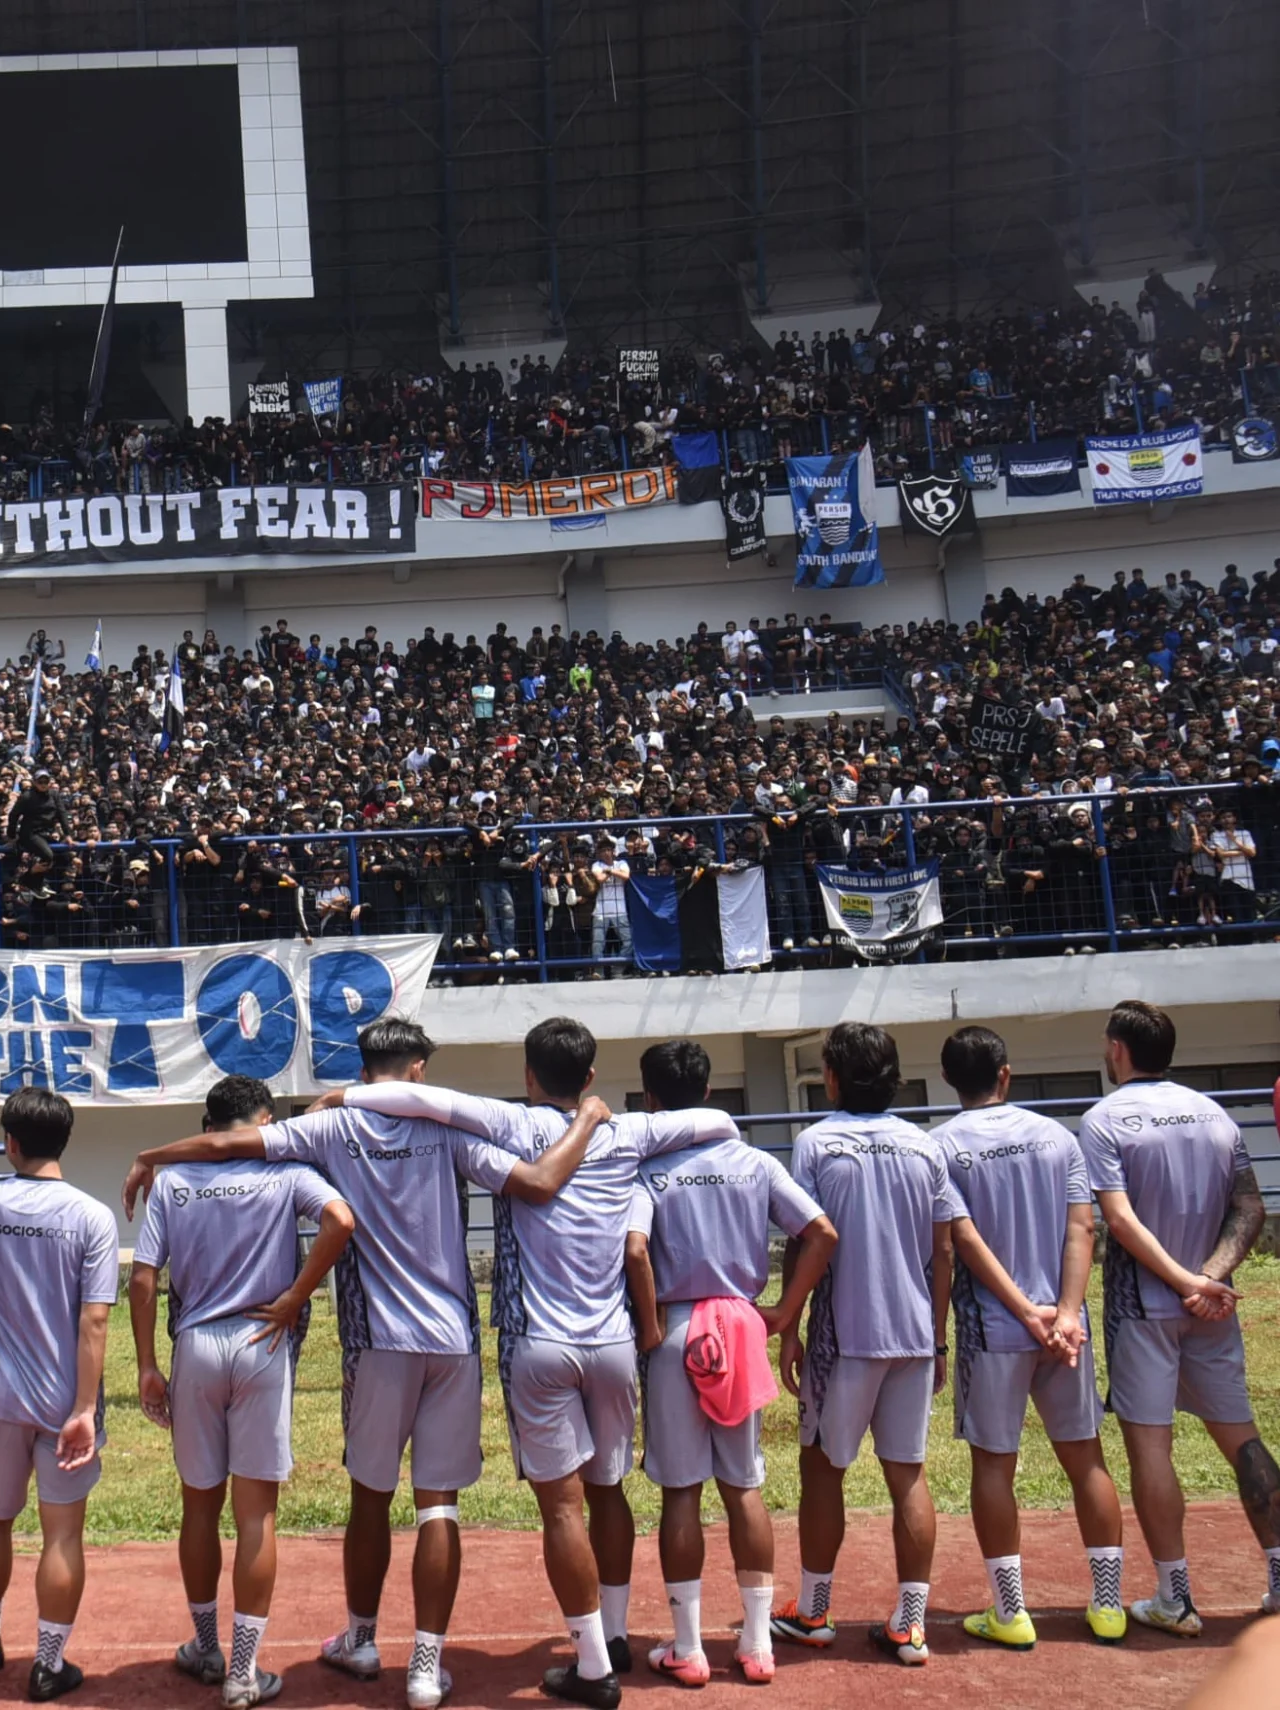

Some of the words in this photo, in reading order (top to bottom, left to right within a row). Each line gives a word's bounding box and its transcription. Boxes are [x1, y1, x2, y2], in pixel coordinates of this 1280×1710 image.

[620, 350, 658, 361] PERSIJA
[619, 361, 660, 373] FUCKING
[254, 392, 281, 403] STAY
[306, 380, 338, 398] HARAM
[249, 399, 290, 413] HIGH
[1089, 439, 1119, 449] THERE
[1120, 438, 1130, 448] IS
[1132, 438, 1140, 447] A
[1141, 434, 1166, 446] BLUE
[1166, 428, 1195, 443] LIGHT
[1096, 490, 1120, 500] THAT
[1121, 487, 1153, 499] NEVER
[1155, 483, 1183, 497] GOES
[217, 486, 369, 540] FEAR
[818, 504, 848, 513] PERSIB
[970, 727, 1028, 753] SEPELE
[828, 873, 859, 886] PERSIB
[859, 876, 869, 887] IS
[870, 877, 883, 887] MY
[884, 873, 908, 887] FIRST
[909, 868, 928, 881] LOVE
[79, 950, 397, 1092] TOP
